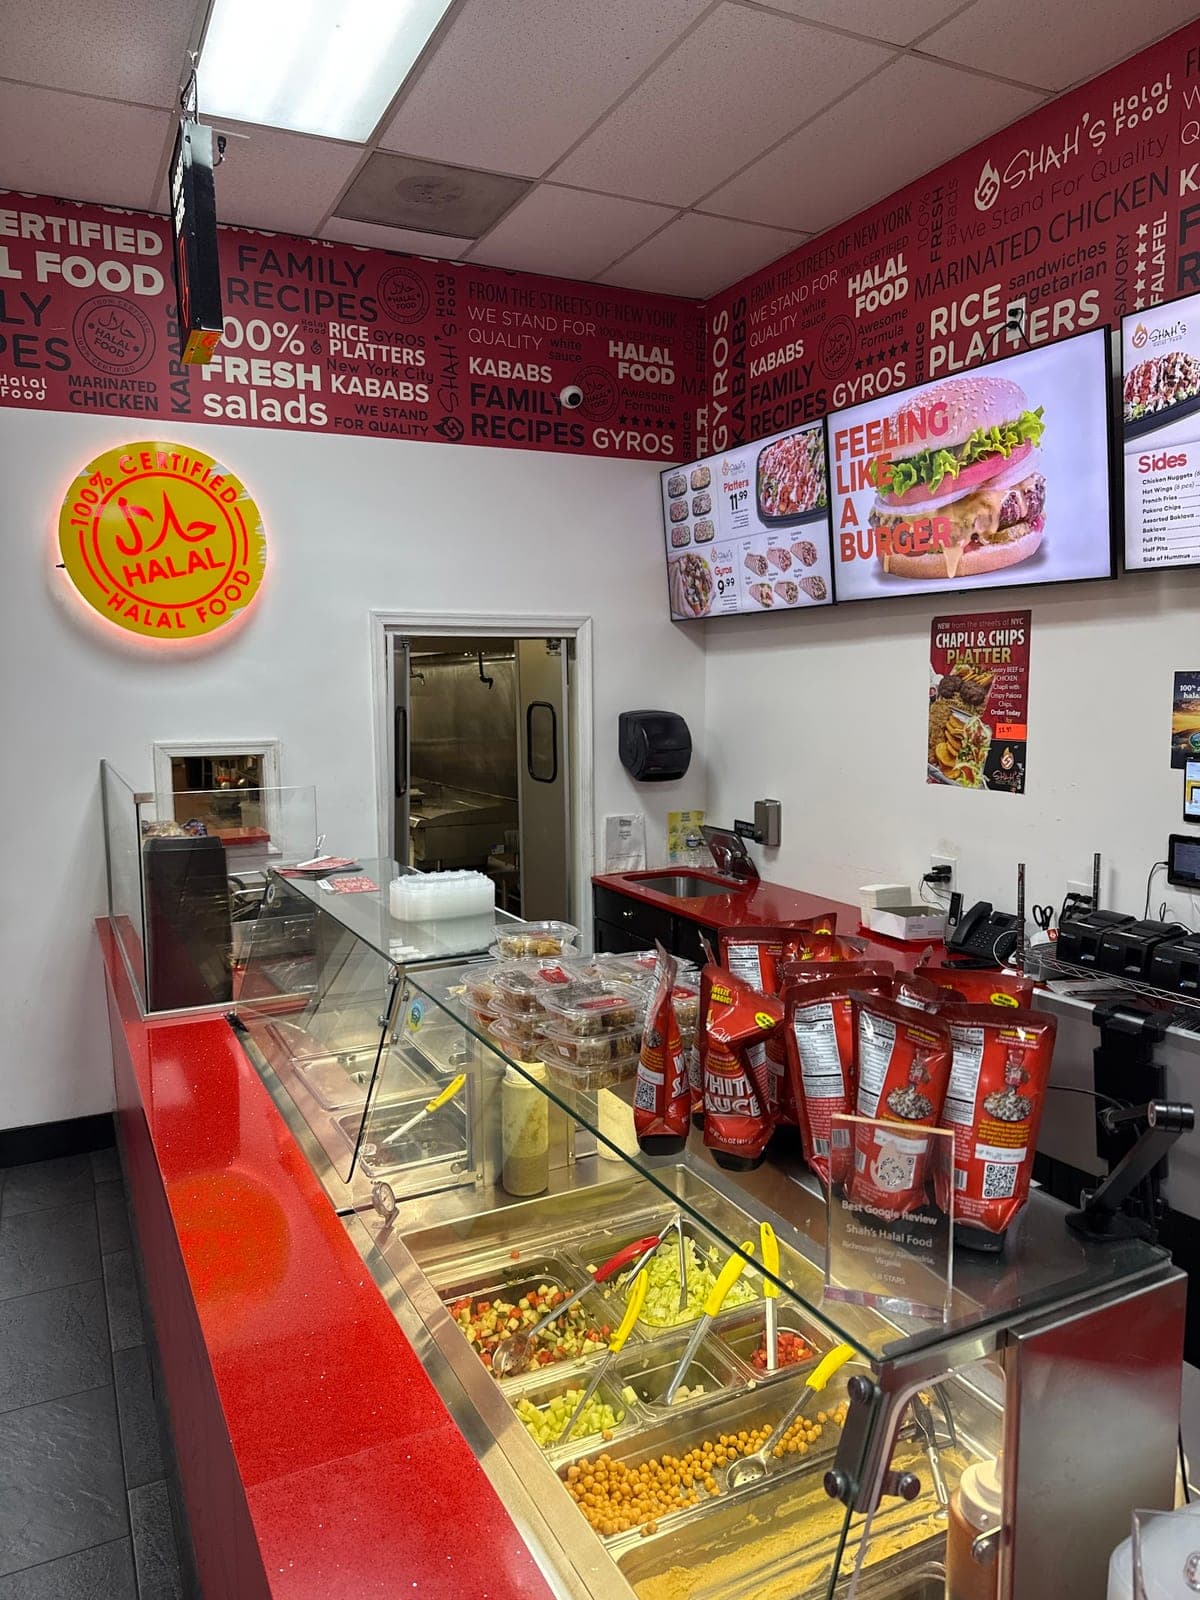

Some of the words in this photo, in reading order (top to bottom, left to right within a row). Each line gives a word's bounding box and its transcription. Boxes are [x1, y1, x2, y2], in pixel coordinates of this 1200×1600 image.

[1113, 72, 1172, 119] Halal
[1115, 93, 1168, 136] Food
[1003, 112, 1106, 190] SHAH'S
[960, 226, 986, 244] We
[991, 192, 1043, 230] Stand
[1050, 175, 1083, 203] For
[1091, 134, 1168, 183] Quality
[914, 225, 1042, 301] MARINATED
[1049, 165, 1168, 244] CHICKEN
[930, 186, 944, 263] FRESH
[238, 245, 365, 288] FAMILY
[751, 281, 775, 304] FROM
[777, 267, 794, 291] THE
[795, 245, 836, 282] STREETS
[837, 237, 853, 259] OF
[853, 221, 880, 249] NEW
[881, 201, 913, 235] YORK
[863, 235, 909, 266] CERTIFIED
[1009, 240, 1107, 290] sandwiches
[1150, 211, 1167, 306] FALAFEL
[35, 251, 165, 296] FOOD
[848, 253, 908, 298] HALAL
[1010, 260, 1108, 308] vegetarian
[1114, 234, 1129, 317] SAVORY
[227, 277, 378, 322] RECIPES
[468, 280, 508, 303] FROM
[511, 287, 535, 308] THE
[539, 292, 592, 317] STREETS
[595, 300, 612, 319] OF
[615, 304, 644, 325] NEW
[750, 308, 767, 326] WE
[770, 285, 809, 317] STAND
[812, 269, 838, 295] FOR
[855, 277, 909, 318] FOOD
[930, 284, 1002, 340] RICE
[329, 321, 369, 342] RICE
[468, 306, 496, 324] WE
[502, 310, 558, 332] STAND
[563, 319, 596, 337] FOR
[750, 312, 798, 347] QUALITY
[857, 307, 908, 337] Awesome
[860, 326, 904, 349] Formula
[94, 338, 125, 358] FOOD
[95, 328, 131, 351] HALAL
[329, 339, 426, 367] PLATTERS
[373, 330, 426, 347] GYROS
[468, 328, 543, 350] QUALITY
[550, 338, 582, 350] white
[608, 340, 674, 366] HALAL
[915, 321, 925, 383] sauce
[201, 355, 321, 392] FRESH
[327, 358, 360, 373] New
[366, 362, 398, 378] York
[404, 366, 433, 385] City
[469, 356, 552, 384] KABABS
[549, 352, 582, 363] sauce
[618, 362, 675, 385] FOOD
[732, 296, 746, 448] KABABS
[750, 339, 804, 378] KABABS
[1, 386, 46, 401] Food
[68, 375, 157, 393] MARINATED
[331, 373, 429, 403] KABABS
[621, 386, 675, 403] Awesome
[713, 310, 728, 453] GYROS
[750, 360, 816, 408] FAMILY
[832, 361, 907, 408] GYROS
[69, 390, 159, 411] CHICKEN
[203, 390, 328, 425] salads
[354, 403, 378, 417] WE
[383, 405, 428, 421] STAND
[470, 383, 564, 416] FAMILY
[624, 398, 671, 415] Formula
[751, 388, 827, 438] RECIPES
[334, 417, 364, 430] FOR
[369, 420, 428, 436] QUALITY
[471, 413, 585, 447] RECIPES
[592, 427, 674, 455] GYROS
[834, 401, 949, 462] FEELING
[836, 452, 896, 496] LIKE
[1138, 452, 1187, 474] Sides
[70, 471, 113, 526] 100%
[119, 451, 237, 504] CERTIFIED
[723, 478, 750, 493] Platters
[729, 491, 748, 511] 11.99
[1154, 486, 1173, 494] Wings
[840, 497, 859, 529] A
[839, 516, 951, 563] BURGER
[123, 547, 226, 587] HALAL
[714, 566, 733, 577] Gyros
[107, 592, 186, 629] HALAL
[196, 570, 250, 623] FOOD
[717, 577, 735, 595] 9.99
[935, 631, 974, 648] CHAPLI
[977, 630, 986, 647] &
[988, 629, 1025, 646] CHIPS
[946, 647, 1011, 664] PLATTER
[1006, 709, 1021, 717] Today
[842, 1200, 863, 1213] Best
[864, 1204, 900, 1220] Google
[902, 1212, 937, 1226] Review
[846, 1223, 877, 1238] Shah's
[879, 1230, 905, 1243] Halal
[906, 1234, 933, 1248] Food
